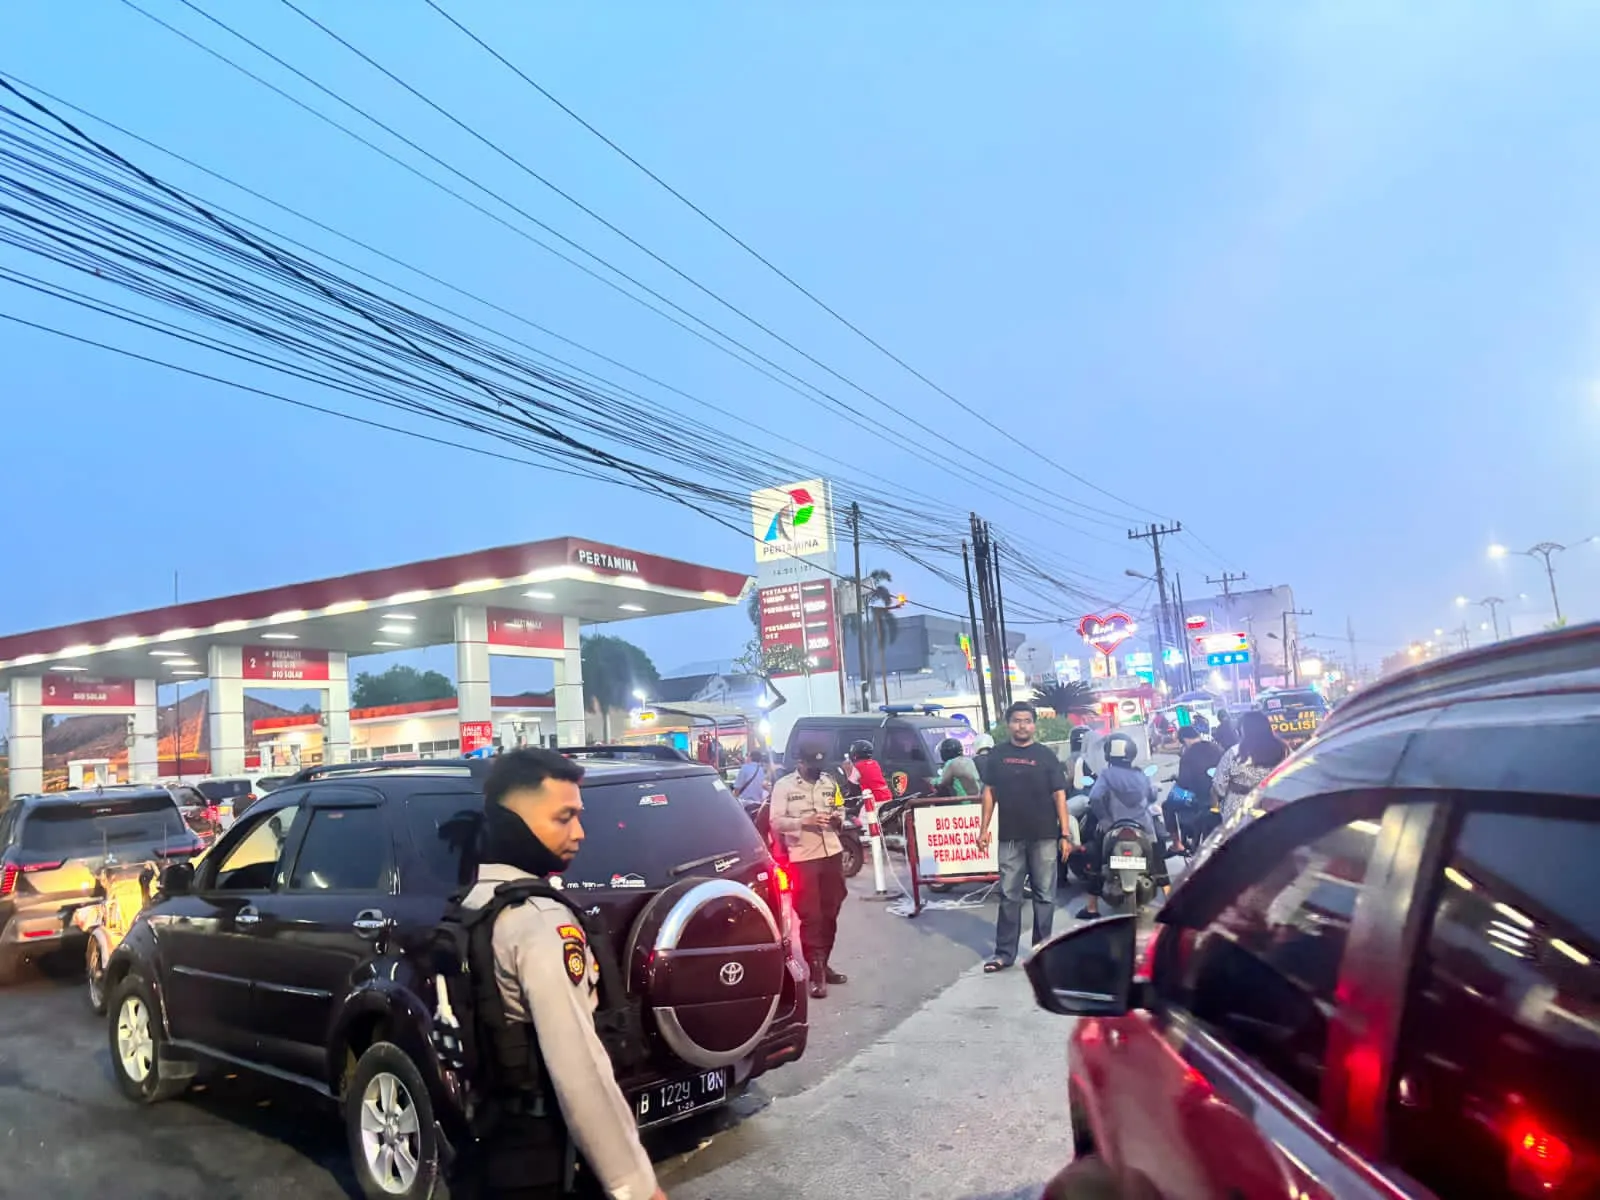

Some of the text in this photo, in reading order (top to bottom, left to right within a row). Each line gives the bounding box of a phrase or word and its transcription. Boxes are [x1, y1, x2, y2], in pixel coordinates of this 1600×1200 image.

[763, 539, 819, 556] PERTAMINA
[578, 549, 639, 573] PERTAMINA
[250, 657, 256, 669] 2
[48, 685, 56, 696] 3
[1270, 718, 1316, 733] POLISI
[935, 815, 980, 830] BIO SOLAR
[927, 832, 962, 847] SEDANG
[934, 848, 990, 862] PERJALANAN
[640, 1093, 650, 1115] B
[660, 1081, 691, 1108] 1229
